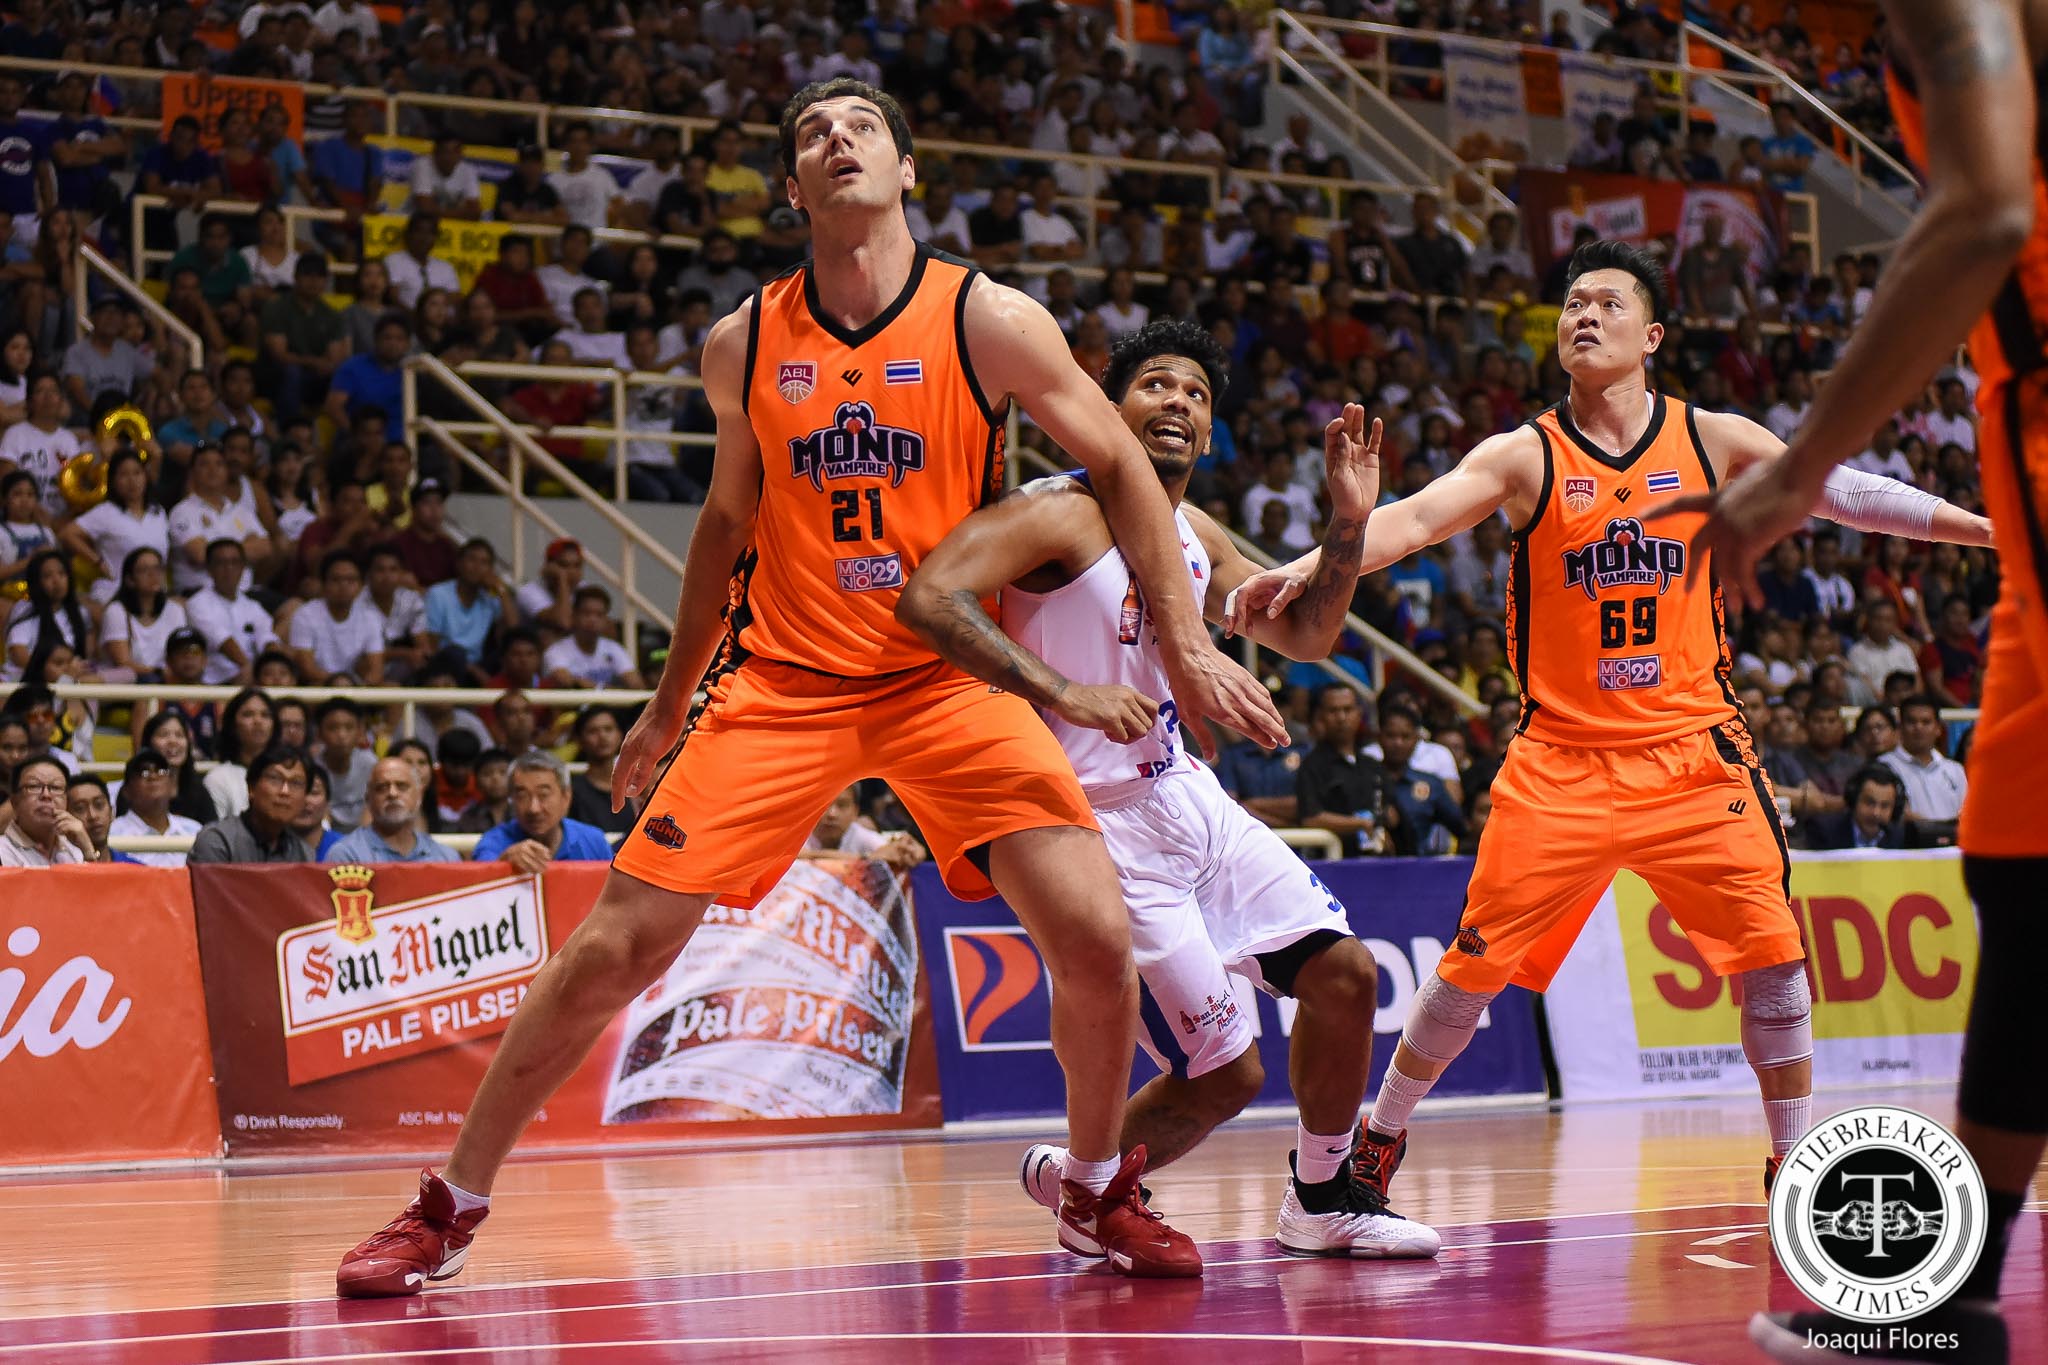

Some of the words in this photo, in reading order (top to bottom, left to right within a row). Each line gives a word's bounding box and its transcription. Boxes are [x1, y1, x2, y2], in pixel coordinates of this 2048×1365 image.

[780, 366, 812, 380] ABL
[789, 427, 924, 491] MONO
[826, 461, 887, 477] VAMPIRE
[1567, 479, 1593, 492] ABL
[831, 487, 884, 542] 21
[871, 556, 900, 584] 29
[1563, 537, 1686, 600] MONO
[1600, 571, 1655, 586] VAMPIRE
[1600, 596, 1658, 648] 69
[1631, 658, 1658, 683] 29
[646, 820, 685, 846] MONO
[303, 942, 384, 1004] San
[388, 897, 525, 988] Miguel
[1648, 892, 1961, 1010] SDC
[341, 1011, 423, 1058] PALE
[660, 989, 770, 1058] Pale
[781, 991, 894, 1067] Pilsen
[1639, 1051, 1673, 1068] FOLLOW
[249, 1114, 277, 1129] Drink
[279, 1114, 344, 1130] Responsibly
